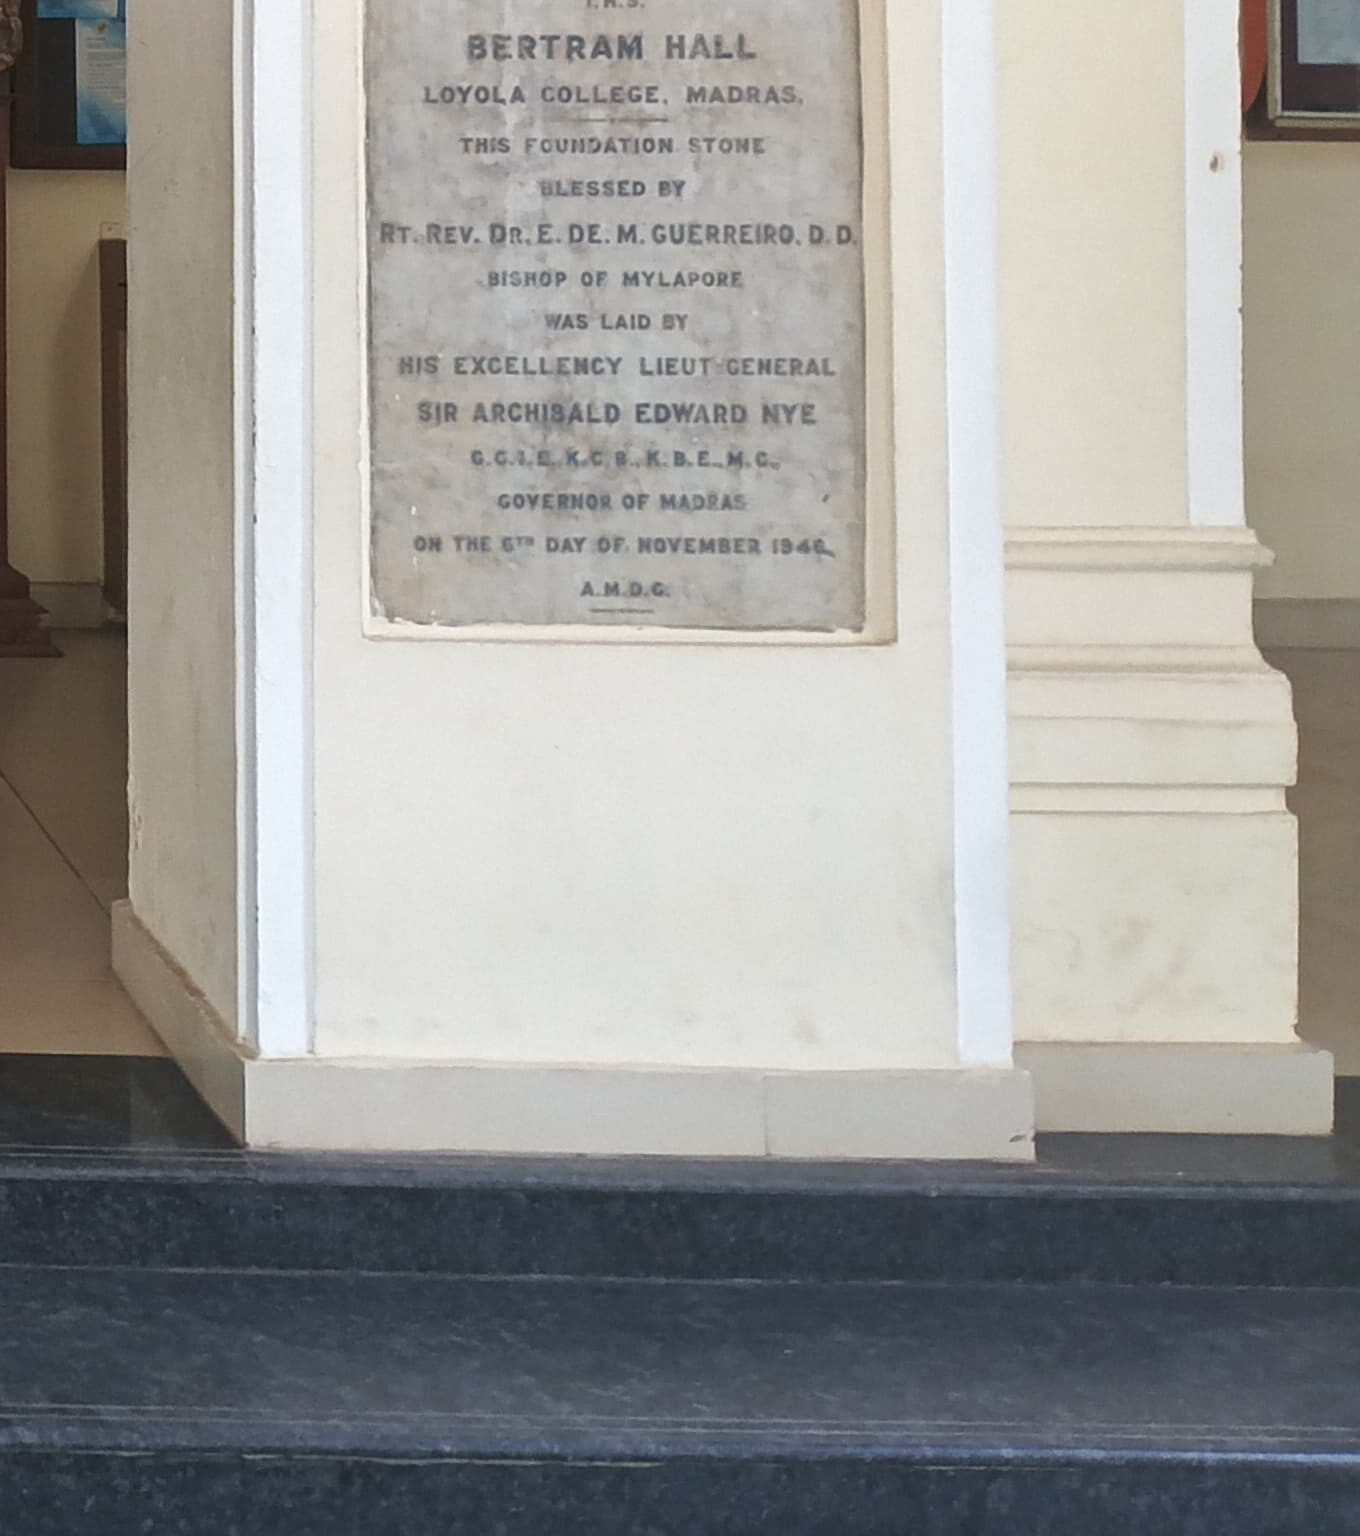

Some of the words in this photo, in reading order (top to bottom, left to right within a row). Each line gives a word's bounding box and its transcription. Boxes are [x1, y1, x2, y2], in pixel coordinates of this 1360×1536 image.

[467, 34, 644, 62] BERTRAM
[665, 34, 758, 61] HALL
[423, 86, 526, 106] LOYOLA
[459, 138, 510, 155] THIS
[525, 137, 673, 155] FOUNDATION
[688, 138, 766, 155] STONE
[539, 179, 646, 198] BLESSED
[659, 179, 687, 198] BY
[488, 270, 567, 288] BISHOP
[580, 271, 609, 288] OF
[623, 271, 743, 288] MYLAPORE
[546, 314, 588, 330] WAS
[601, 314, 651, 330] LAID
[663, 314, 688, 331] BY
[399, 356, 439, 376] HIS
[453, 355, 623, 376] EXCELLENCY
[418, 403, 459, 426] SIR
[472, 402, 621, 424] ARCHIBALD
[635, 403, 747, 424] EDWARD
[761, 403, 817, 425] NYE
[498, 493, 612, 511] GOVERNOR
[622, 493, 650, 510] OF
[660, 494, 746, 511] MADRAS
[413, 537, 441, 554] ON
[452, 536, 490, 553] THE
[546, 538, 586, 555] DAY
[597, 538, 625, 555] OF
[638, 538, 761, 556] NOVEMBER
